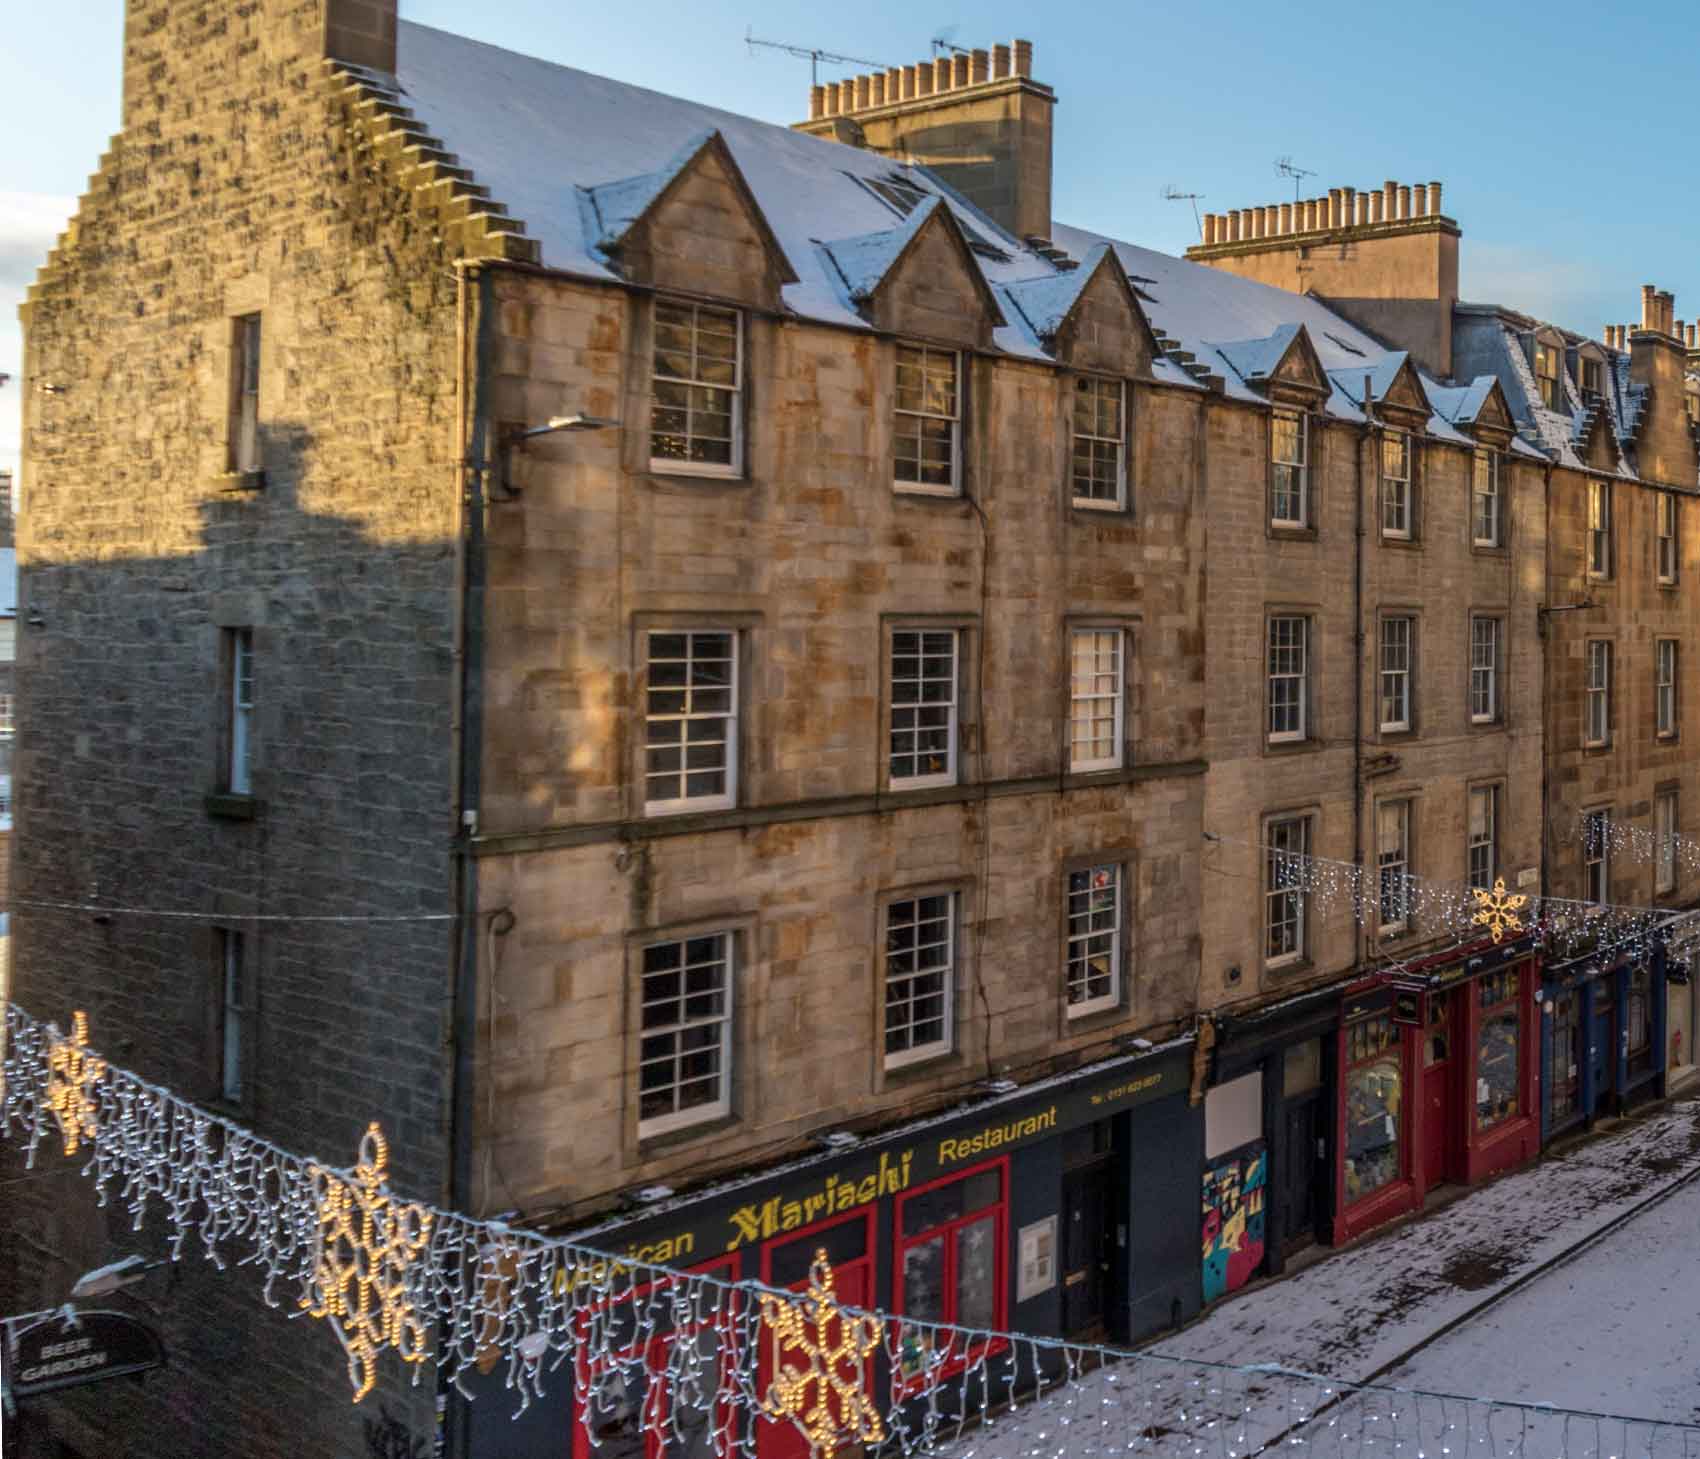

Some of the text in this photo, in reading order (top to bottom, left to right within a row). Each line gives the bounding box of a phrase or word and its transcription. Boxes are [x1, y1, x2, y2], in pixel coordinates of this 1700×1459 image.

[727, 1148, 915, 1252] Mariachi
[938, 1105, 1057, 1166] Restaurant
[41, 1338, 91, 1360] BEER
[21, 1352, 107, 1381] GARDEN
